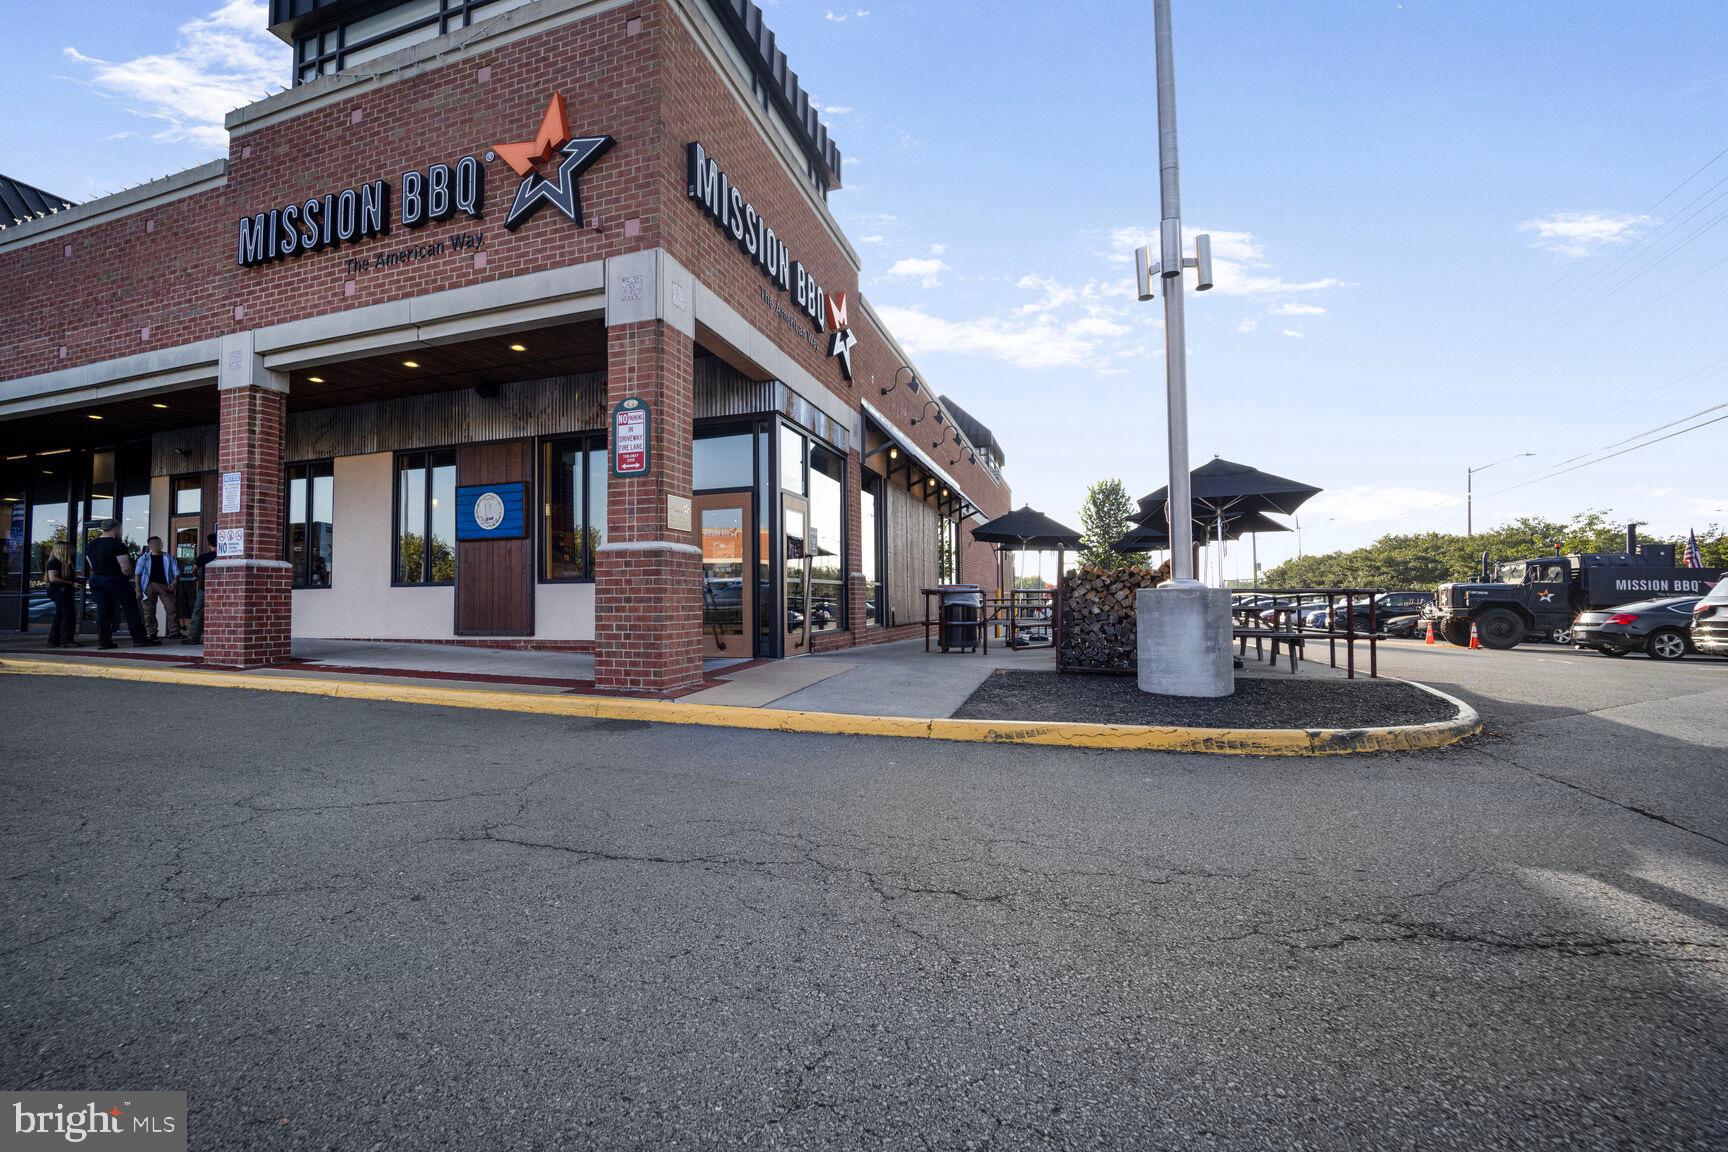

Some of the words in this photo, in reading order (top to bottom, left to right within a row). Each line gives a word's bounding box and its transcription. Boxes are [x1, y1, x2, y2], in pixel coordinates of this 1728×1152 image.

[238, 179, 390, 267] MISSION
[401, 155, 484, 229] BBQ
[688, 141, 789, 292] MISSION
[791, 260, 826, 334] BBQ
[347, 257, 369, 275] The
[375, 242, 445, 269] American
[759, 284, 773, 309] The
[775, 301, 808, 340] American
[618, 413, 628, 425] NO
[628, 414, 643, 422] PARKING
[619, 435, 643, 443] DRIVEWAY
[630, 443, 643, 451] LANE
[218, 541, 228, 554] NO
[1616, 579, 1669, 591] MISSION
[1674, 580, 1699, 592] BBQ
